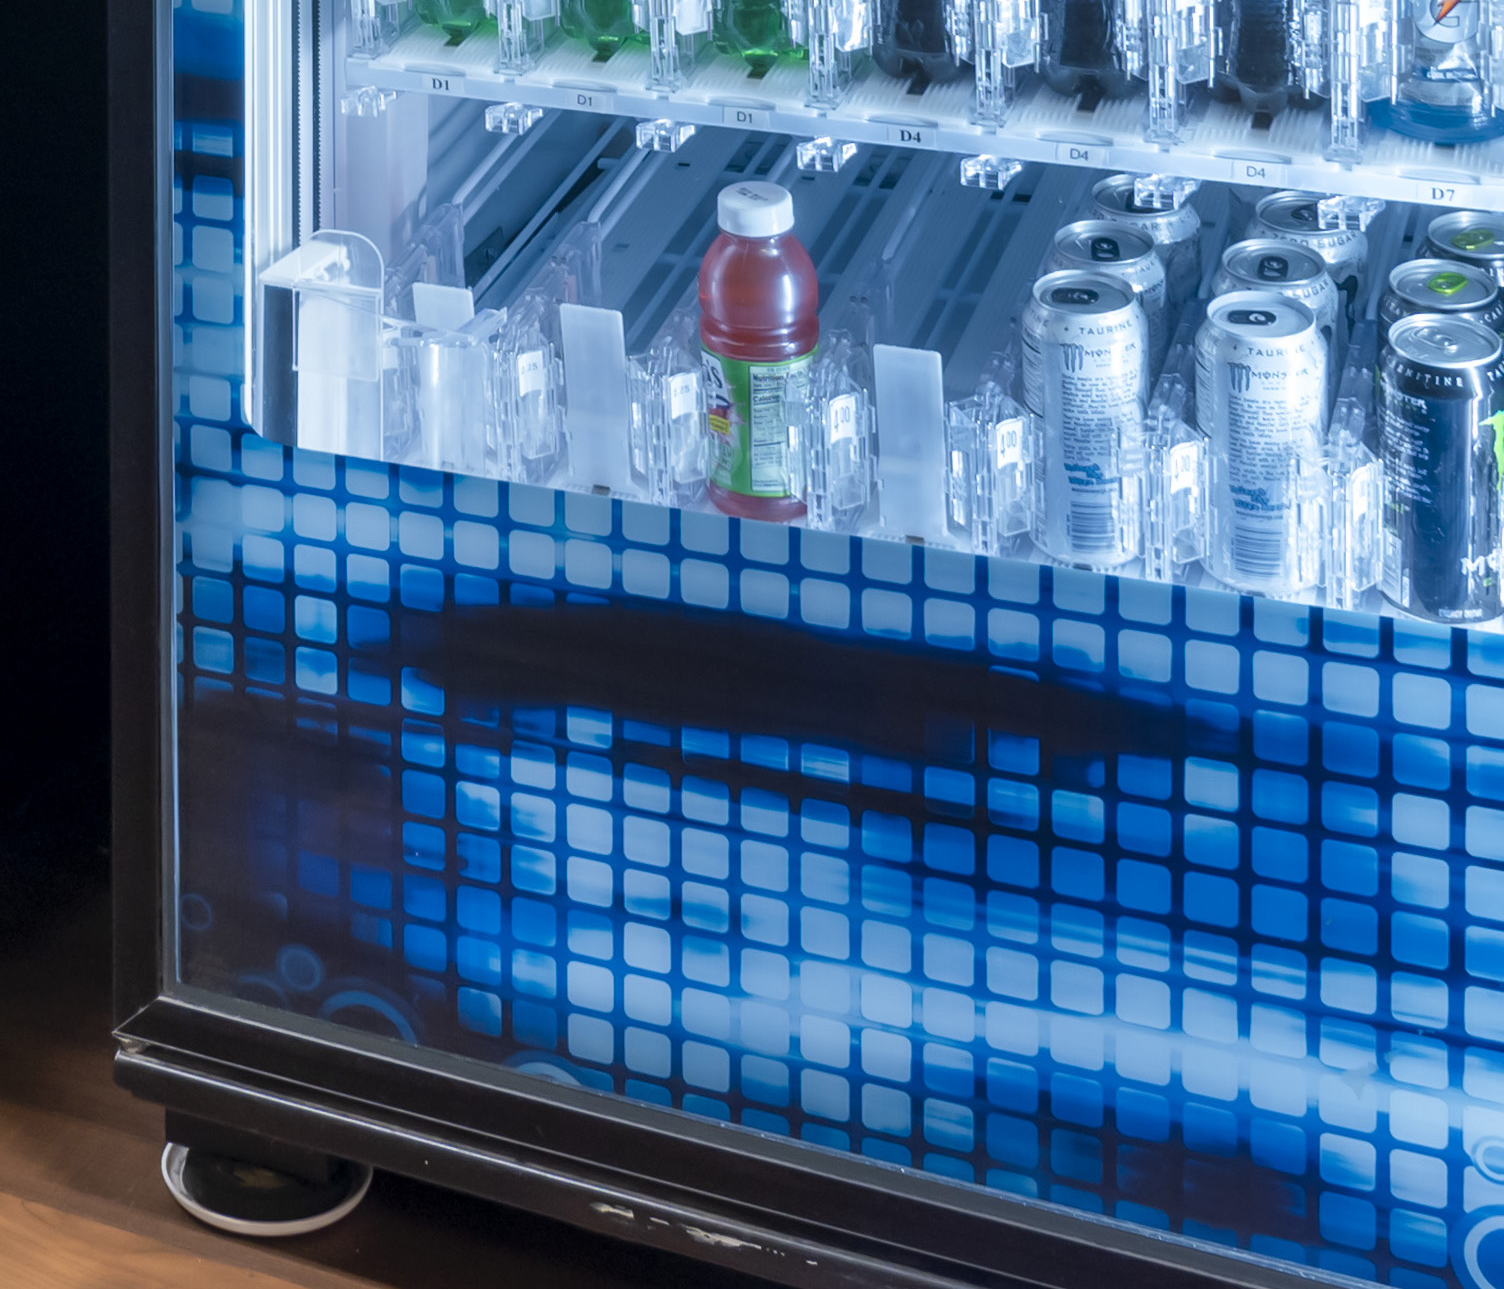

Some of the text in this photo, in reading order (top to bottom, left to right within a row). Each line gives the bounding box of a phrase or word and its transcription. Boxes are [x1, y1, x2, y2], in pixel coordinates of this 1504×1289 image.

[431, 77, 450, 92] D1
[899, 129, 922, 143] D4
[1430, 187, 1456, 202] D7
